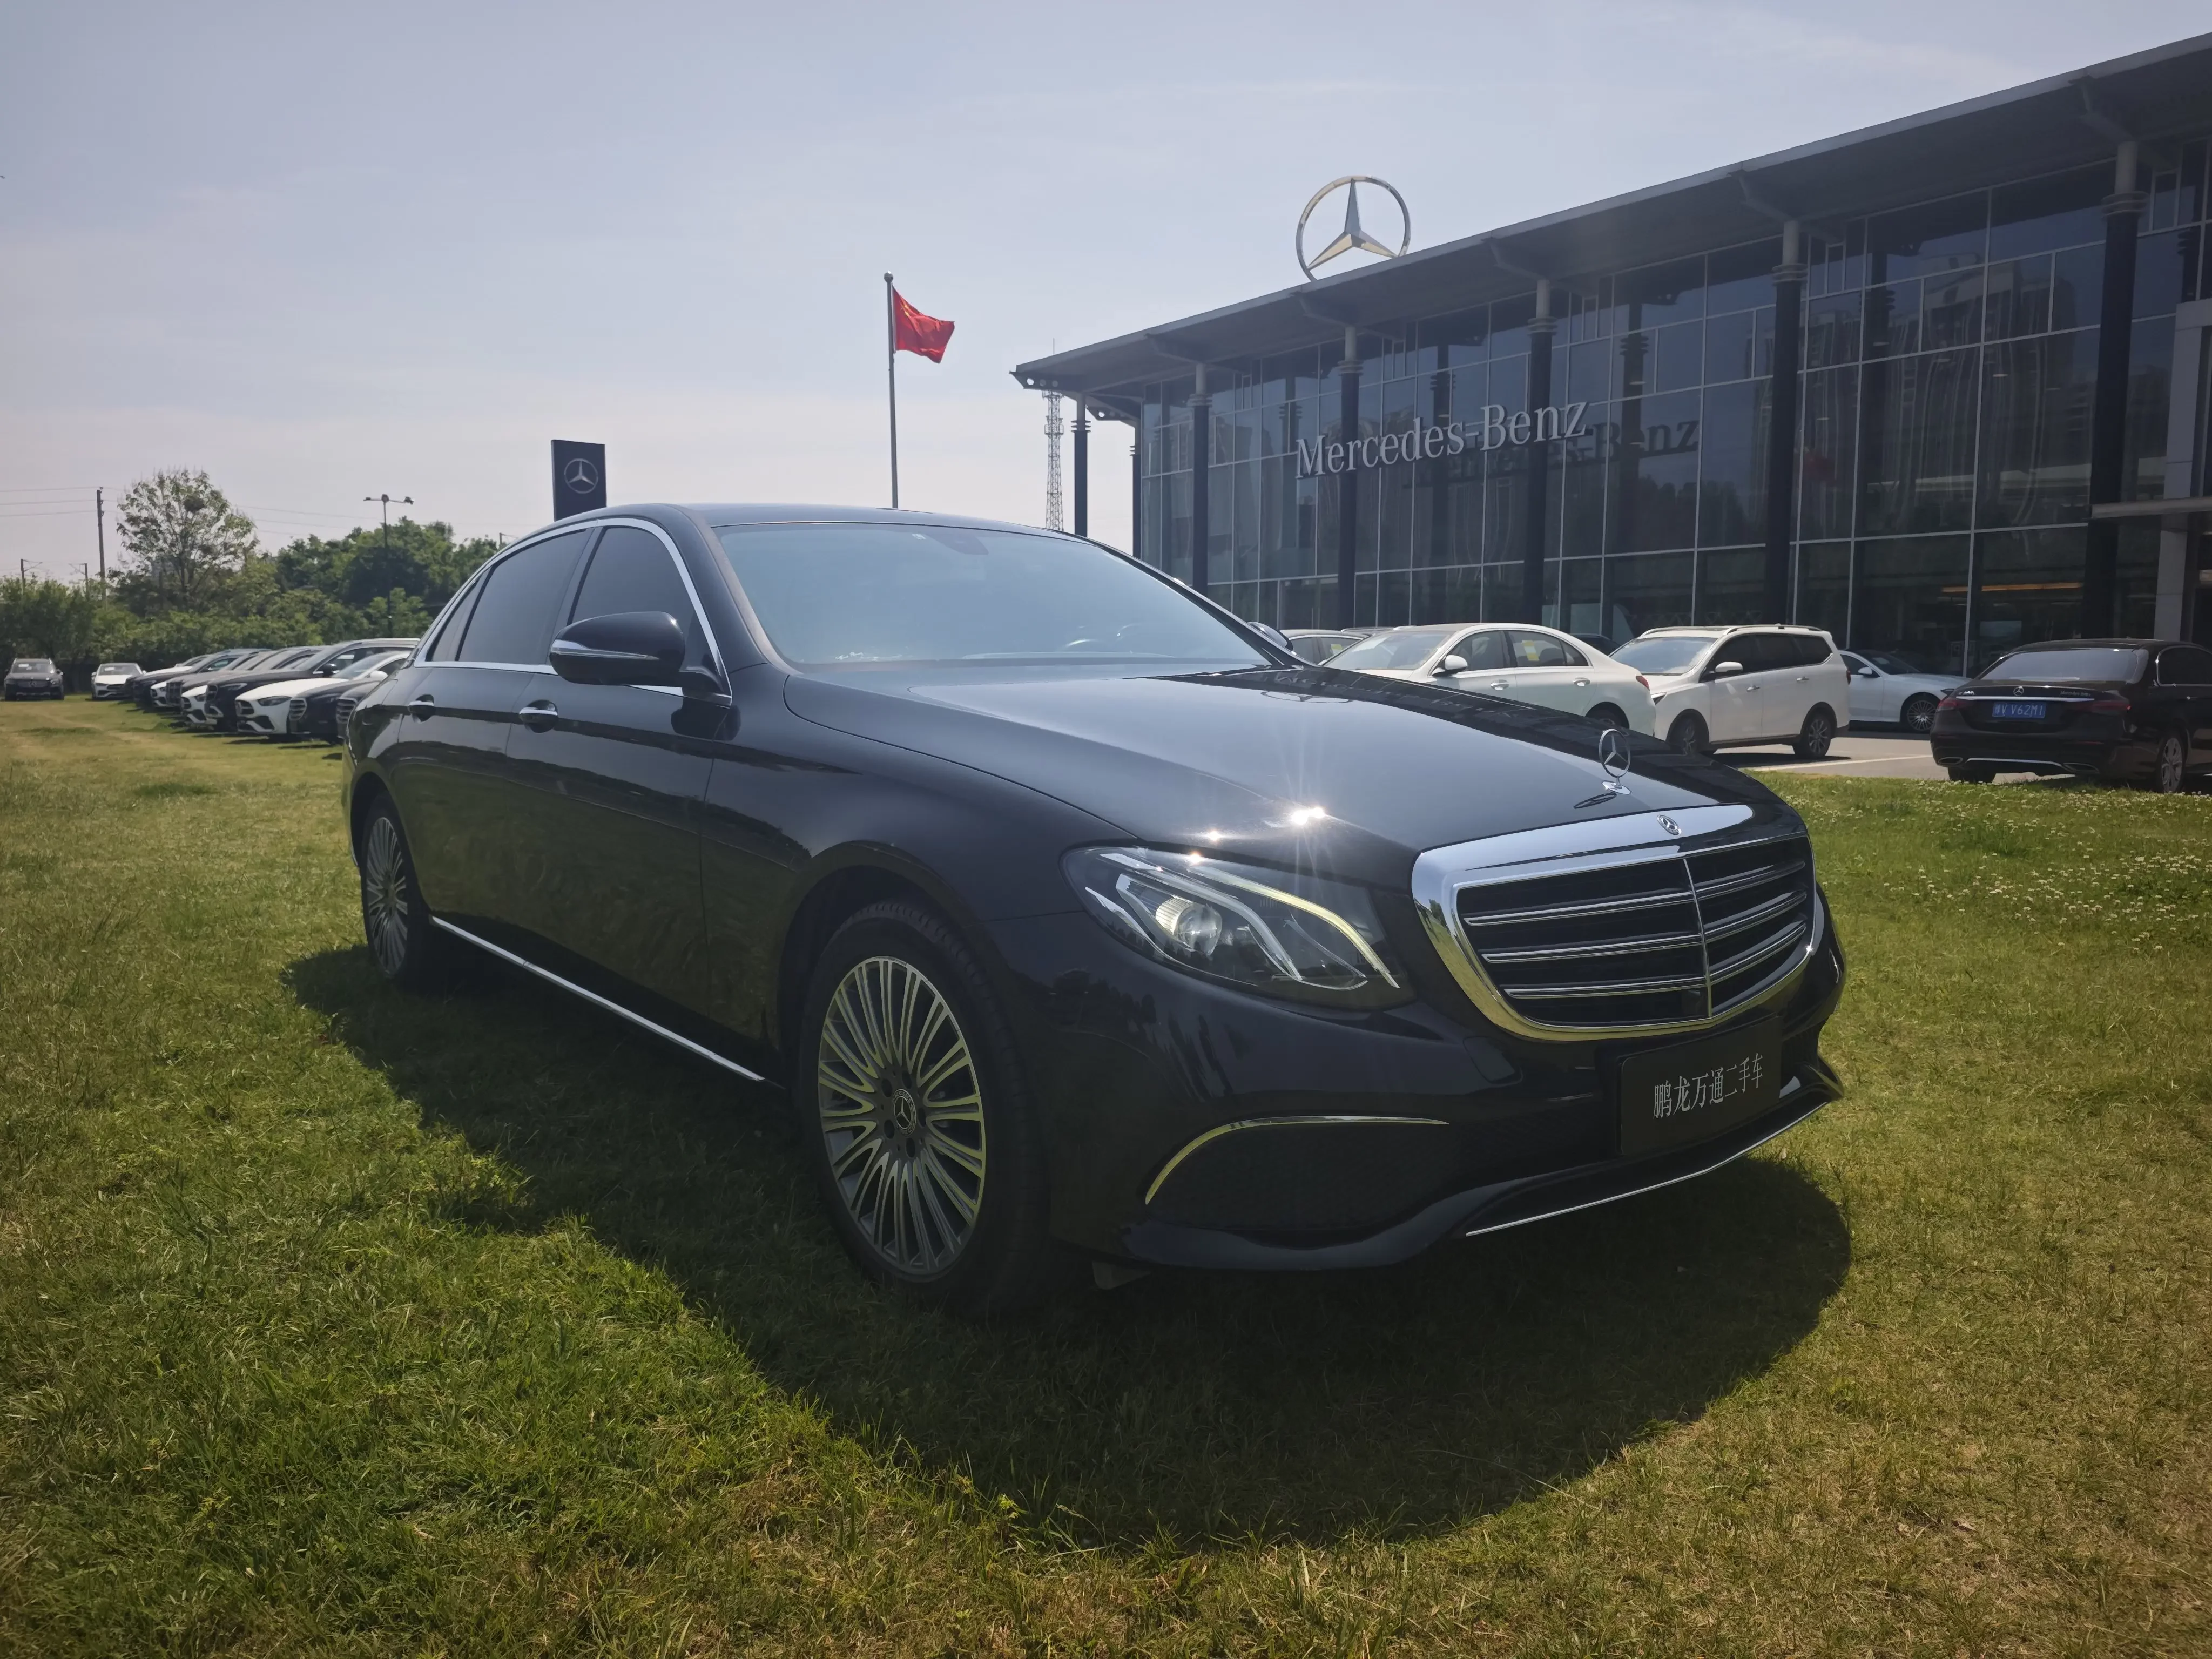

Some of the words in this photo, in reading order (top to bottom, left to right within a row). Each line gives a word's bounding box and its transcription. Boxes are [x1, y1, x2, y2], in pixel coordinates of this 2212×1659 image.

[1295, 401, 1588, 478] Mercedes-Benz
[1653, 1053, 1763, 1119] 鹏龙万通二手车
